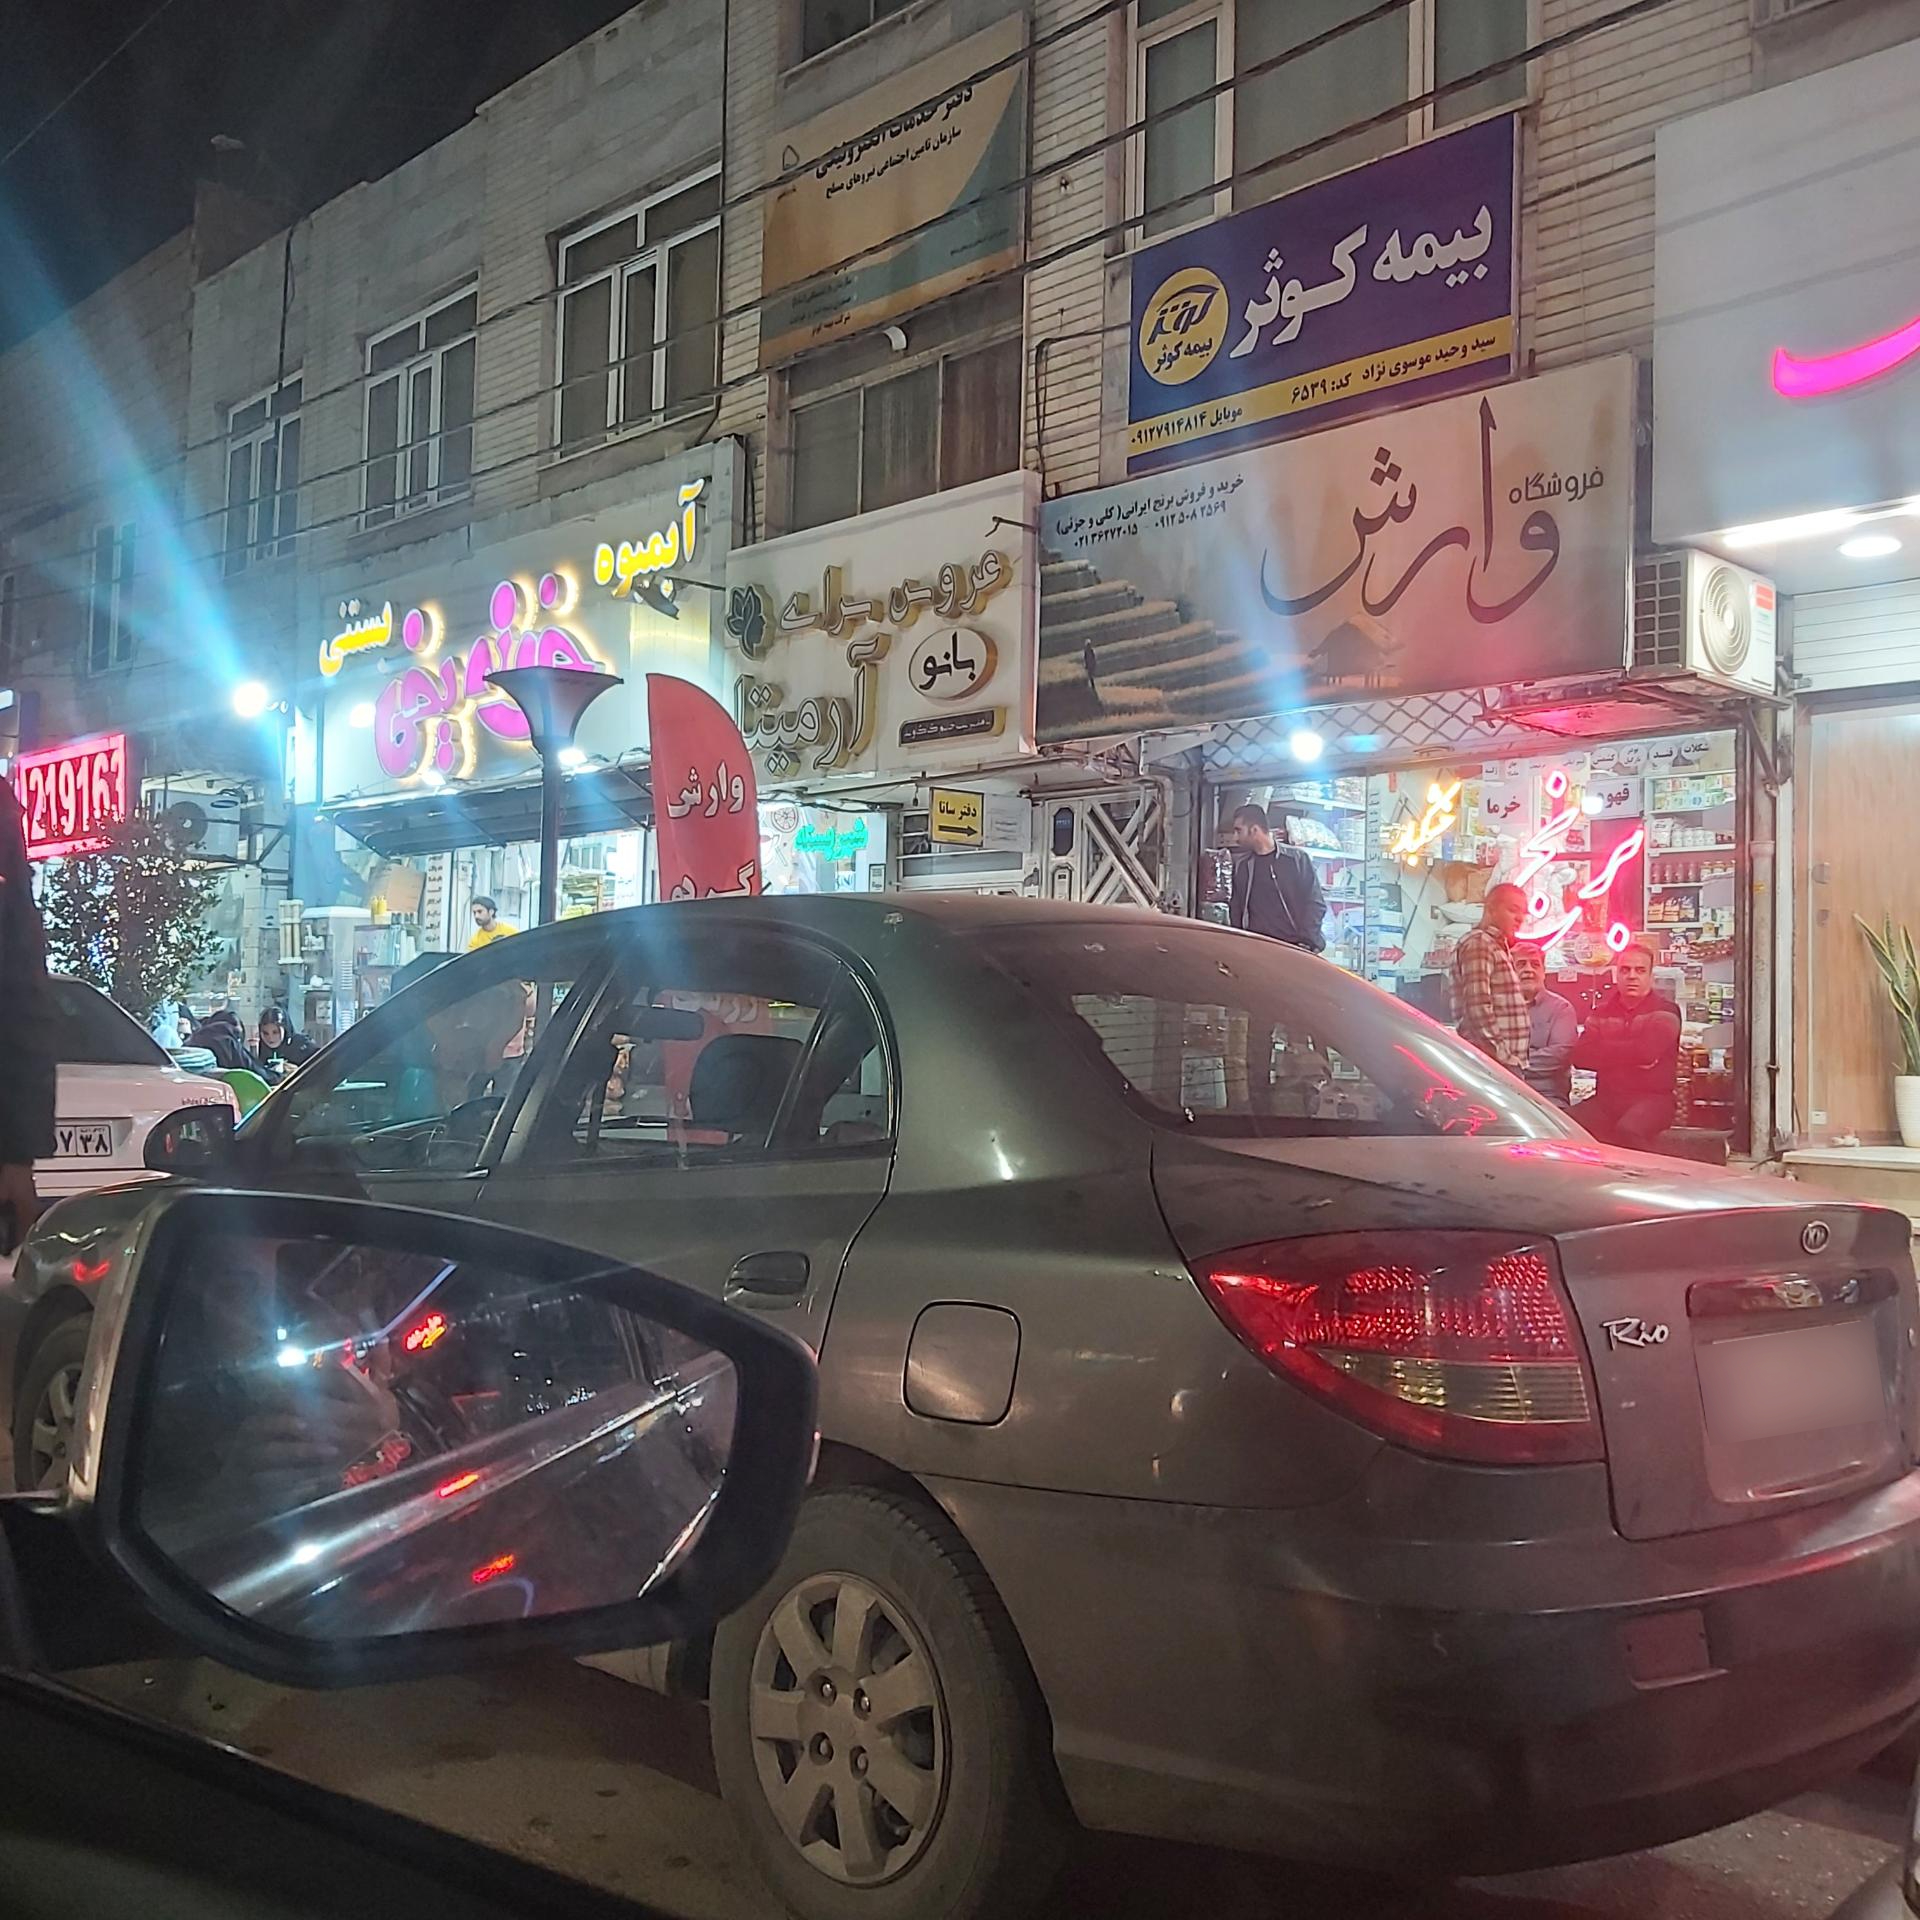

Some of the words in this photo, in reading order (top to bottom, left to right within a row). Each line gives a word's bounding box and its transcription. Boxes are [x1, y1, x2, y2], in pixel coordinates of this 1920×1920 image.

[1372, 204, 1493, 290] بیمه
[1229, 223, 1368, 359] کوثر
[1152, 340, 1184, 375] کوثر
[1183, 337, 1213, 359] بیمه
[1434, 343, 1469, 364] وحید
[1470, 335, 1497, 351] سید
[1361, 360, 1387, 382] نژاد
[1388, 351, 1433, 378] موسوی
[1290, 379, 1328, 405] ۶۵۳۹
[1130, 411, 1208, 445] ۰۹۱۲۷۹۱۴۸۱۴
[1209, 406, 1244, 427] موبایل
[1175, 481, 1207, 507] فروش
[1217, 473, 1245, 494] خرید
[1508, 466, 1605, 505] فروشگاه
[1152, 494, 1175, 513] برنج
[1259, 395, 1561, 624] وارش
[594, 479, 704, 598] آبمیوه
[779, 564, 880, 637] سرای
[888, 549, 1005, 624] عروس
[319, 599, 393, 676] بستنی
[918, 631, 976, 691] بانو
[733, 632, 889, 778] آرمیتا
[1683, 741, 1711, 754] شکلات
[666, 760, 745, 819] وارش
[938, 800, 956, 816] سانا
[958, 801, 978, 821] دفتر
[1486, 796, 1522, 819] خرما
[1600, 1316, 1669, 1350] Rio
